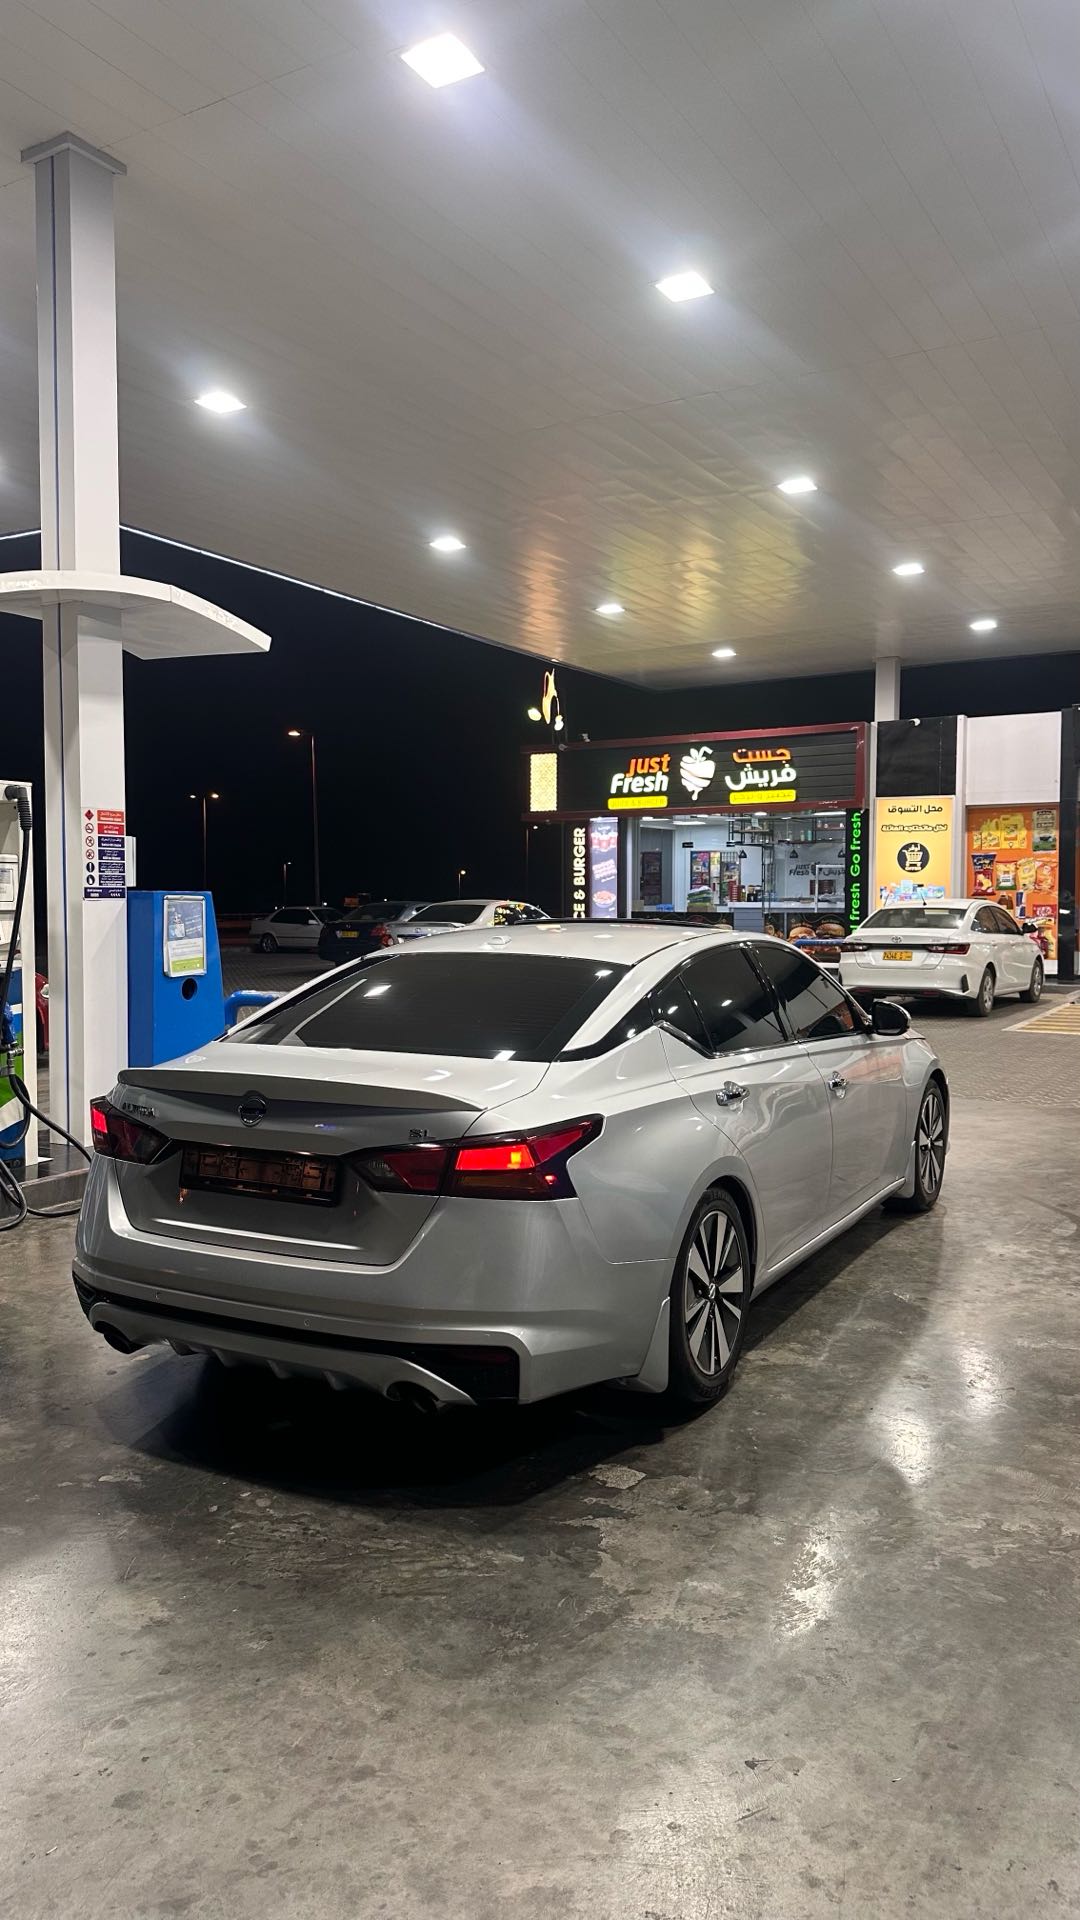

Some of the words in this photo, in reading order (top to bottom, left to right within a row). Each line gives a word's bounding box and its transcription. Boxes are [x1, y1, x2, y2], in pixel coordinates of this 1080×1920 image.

[625, 753, 671, 777] just
[732, 748, 791, 763] جست
[610, 770, 669, 794] Fresh
[724, 763, 797, 791] فريش
[887, 804, 922, 815] التسوق
[923, 804, 943, 814] محل
[850, 812, 862, 851] fresh
[573, 827, 586, 886] BURGER
[850, 853, 861, 877] Go
[573, 889, 586, 900] &
[849, 882, 860, 921] fresh
